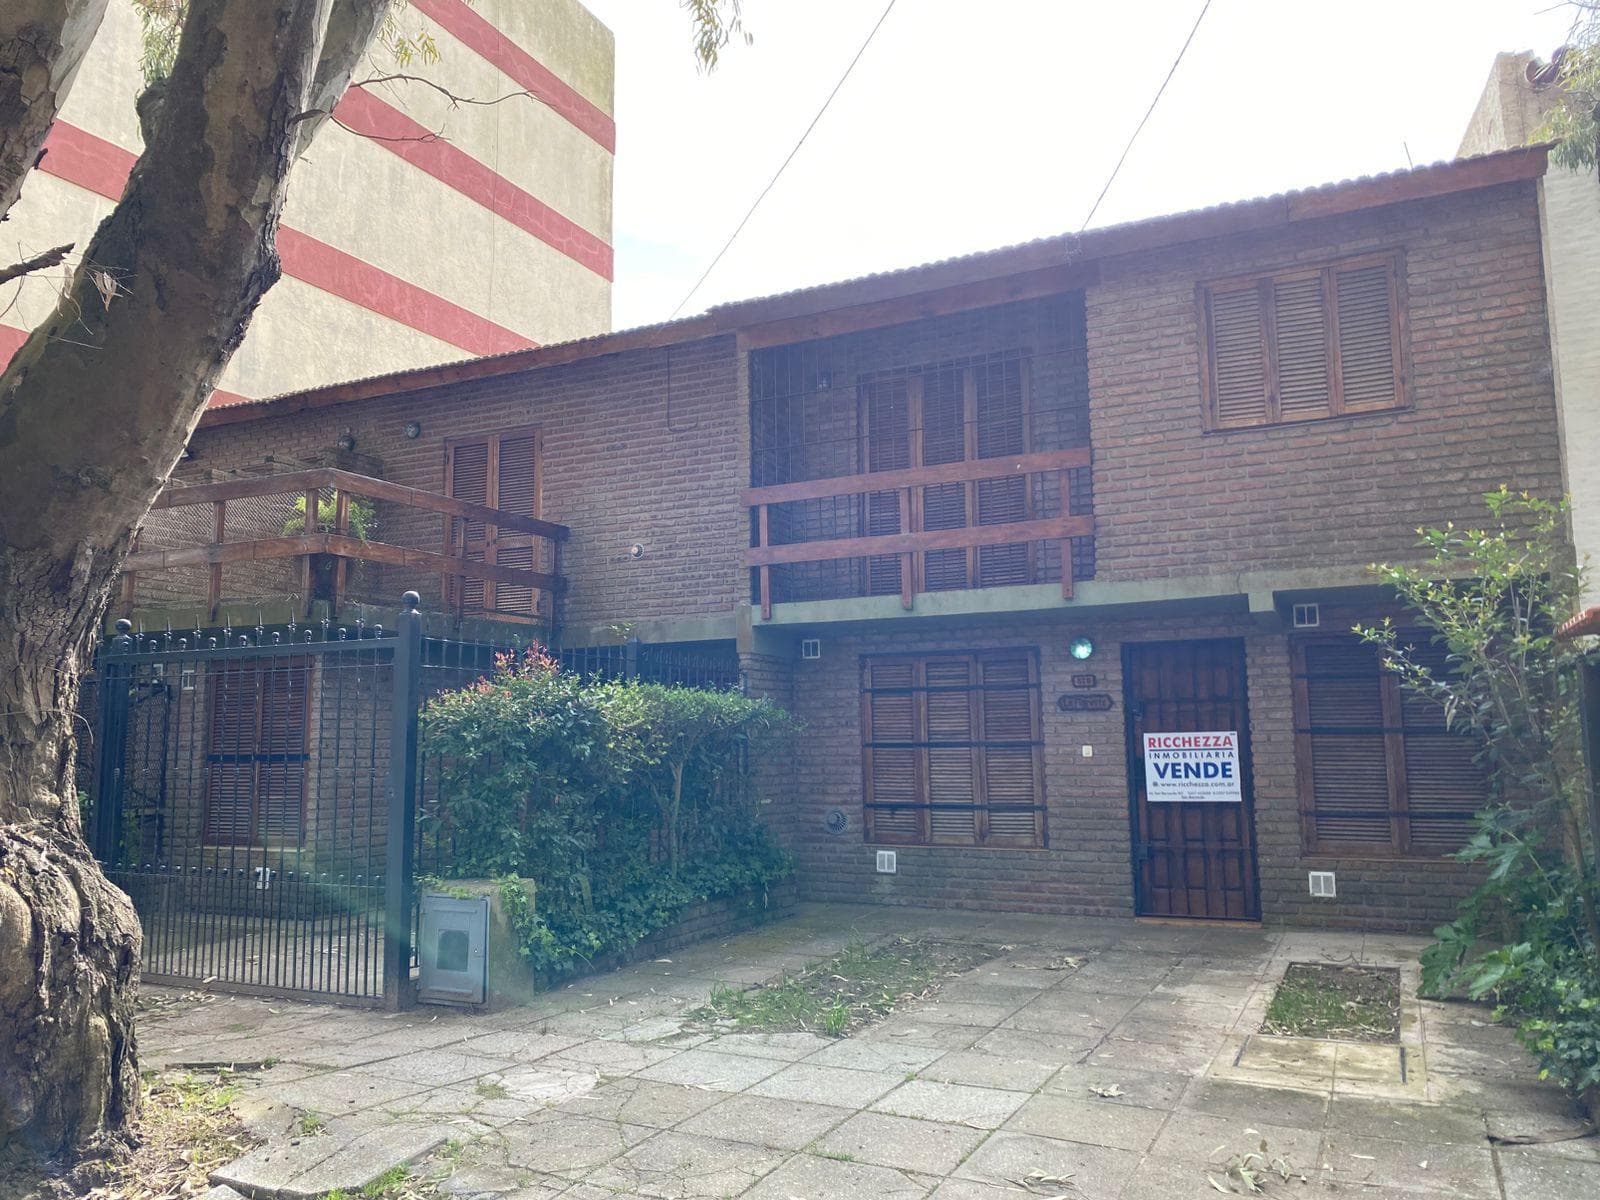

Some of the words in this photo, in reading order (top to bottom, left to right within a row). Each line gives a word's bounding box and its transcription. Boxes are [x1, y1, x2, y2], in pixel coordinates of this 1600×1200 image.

[1147, 735, 1233, 748] RICCHEZZA
[1148, 751, 1234, 759] INMOBILIARIA
[1153, 761, 1233, 779] VENDE
